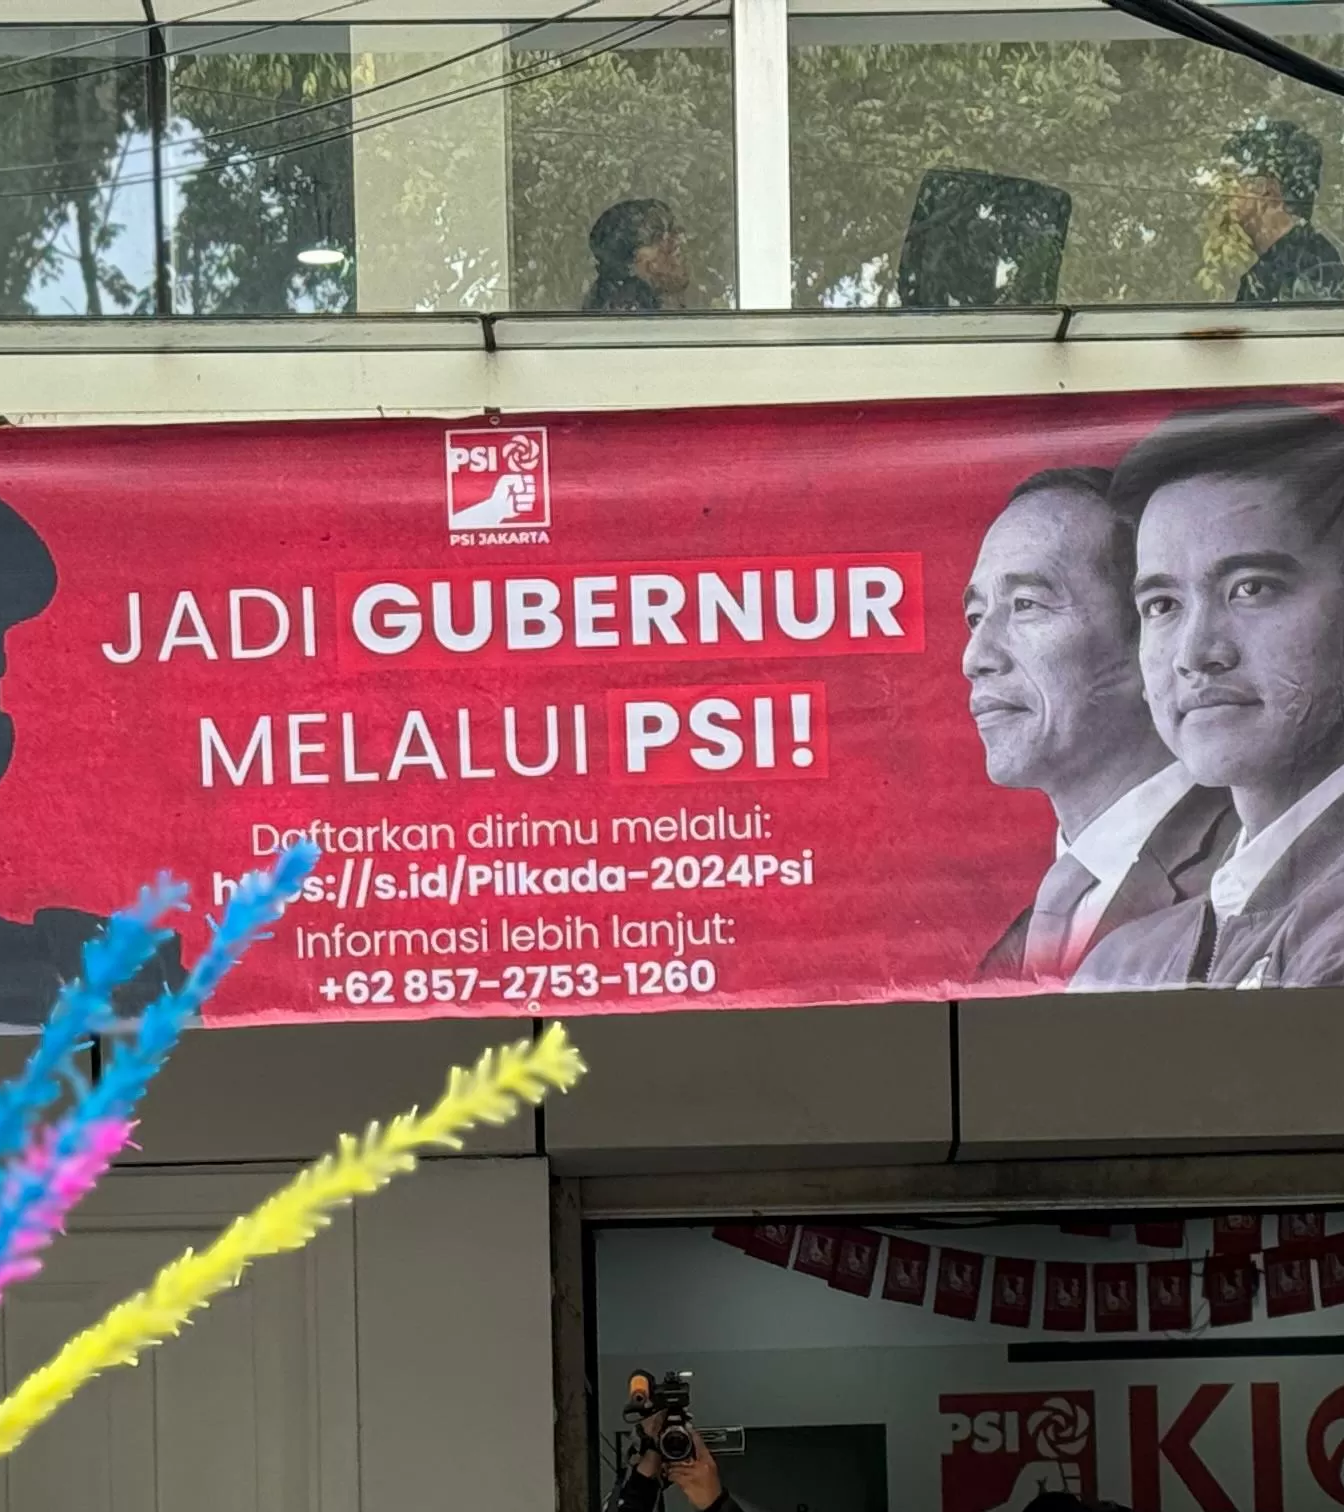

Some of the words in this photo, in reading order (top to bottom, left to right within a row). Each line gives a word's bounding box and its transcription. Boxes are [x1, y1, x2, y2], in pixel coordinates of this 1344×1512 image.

[448, 446, 497, 473] PSI
[450, 533, 475, 546] PSI
[478, 531, 550, 545] JAKARTA
[101, 586, 316, 664] JADI
[351, 566, 906, 655] GUBERNUR
[199, 703, 588, 788] MELALUI
[624, 693, 814, 774] PSI!
[467, 812, 599, 849] dirimu
[611, 804, 772, 843] melalui:
[212, 849, 814, 909] hs://s.id/Pilkada-2024Psi
[296, 918, 488, 959] Informasi
[501, 915, 599, 952] lebih
[612, 912, 736, 956] lanjut:
[319, 969, 396, 1004] +62
[404, 959, 716, 1003] 857-2753-1260
[940, 1411, 1020, 1455] PSI
